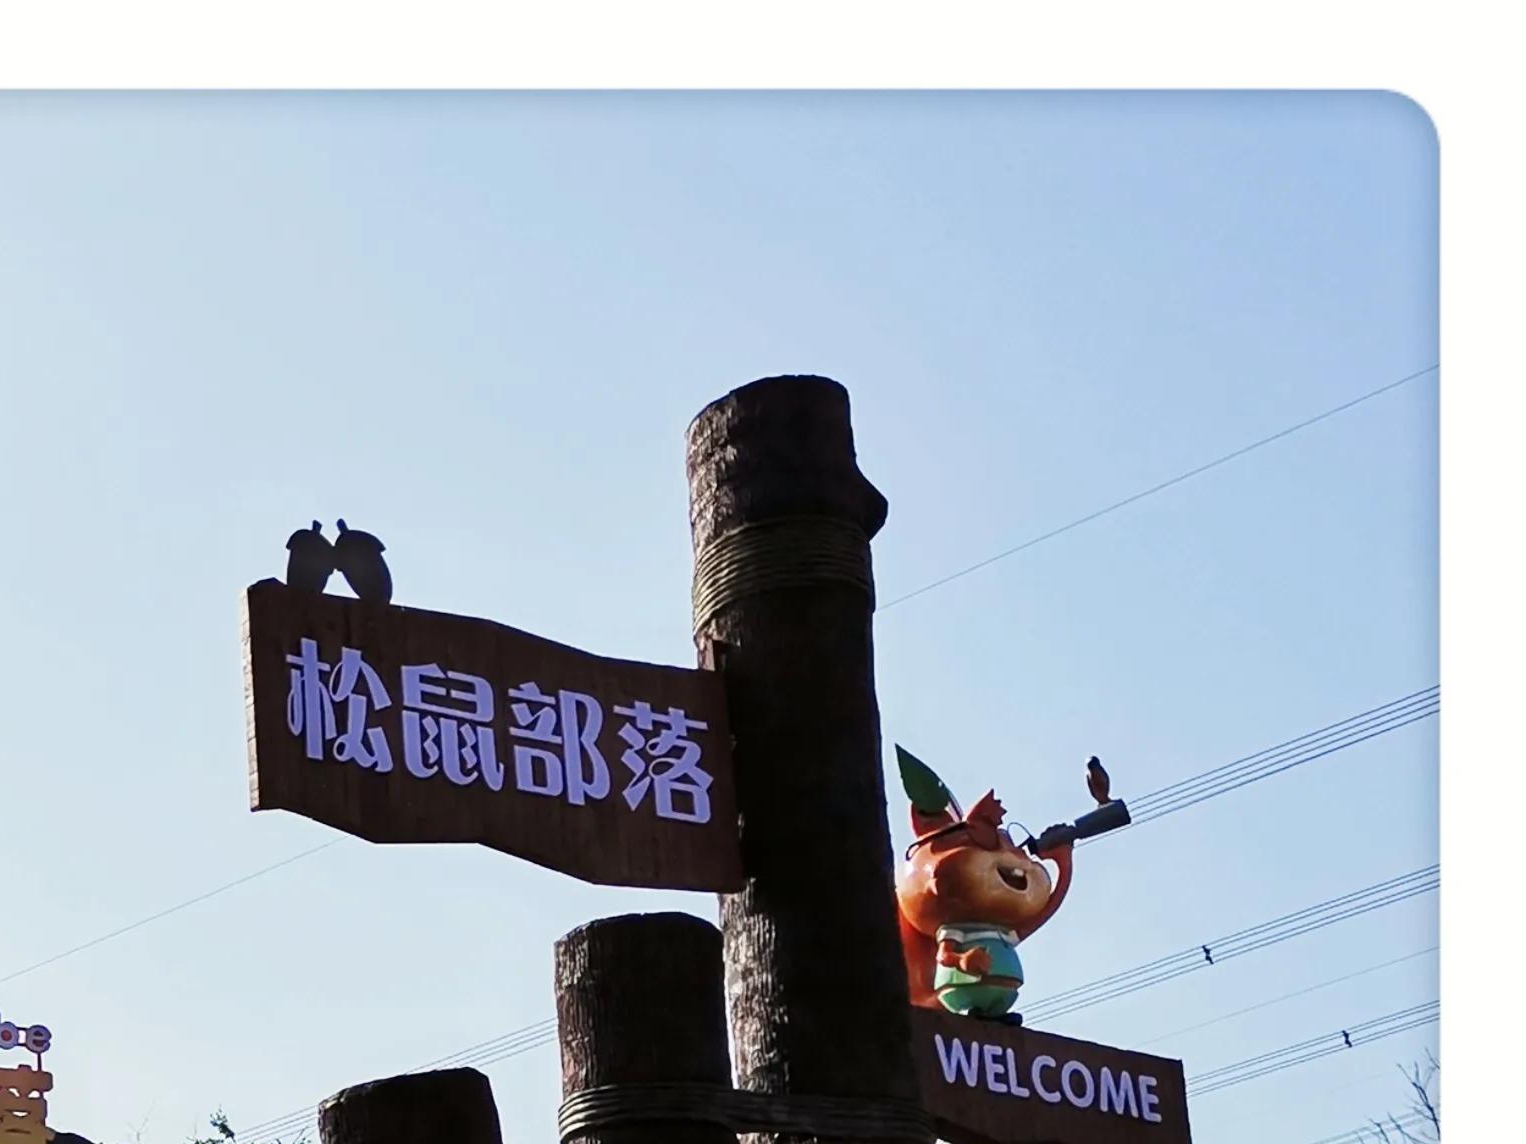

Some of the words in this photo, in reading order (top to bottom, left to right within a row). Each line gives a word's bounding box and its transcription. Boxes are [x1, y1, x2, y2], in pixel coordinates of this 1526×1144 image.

[285, 637, 714, 824] 松鼠部落
[934, 1033, 1162, 1123] WELCOME
